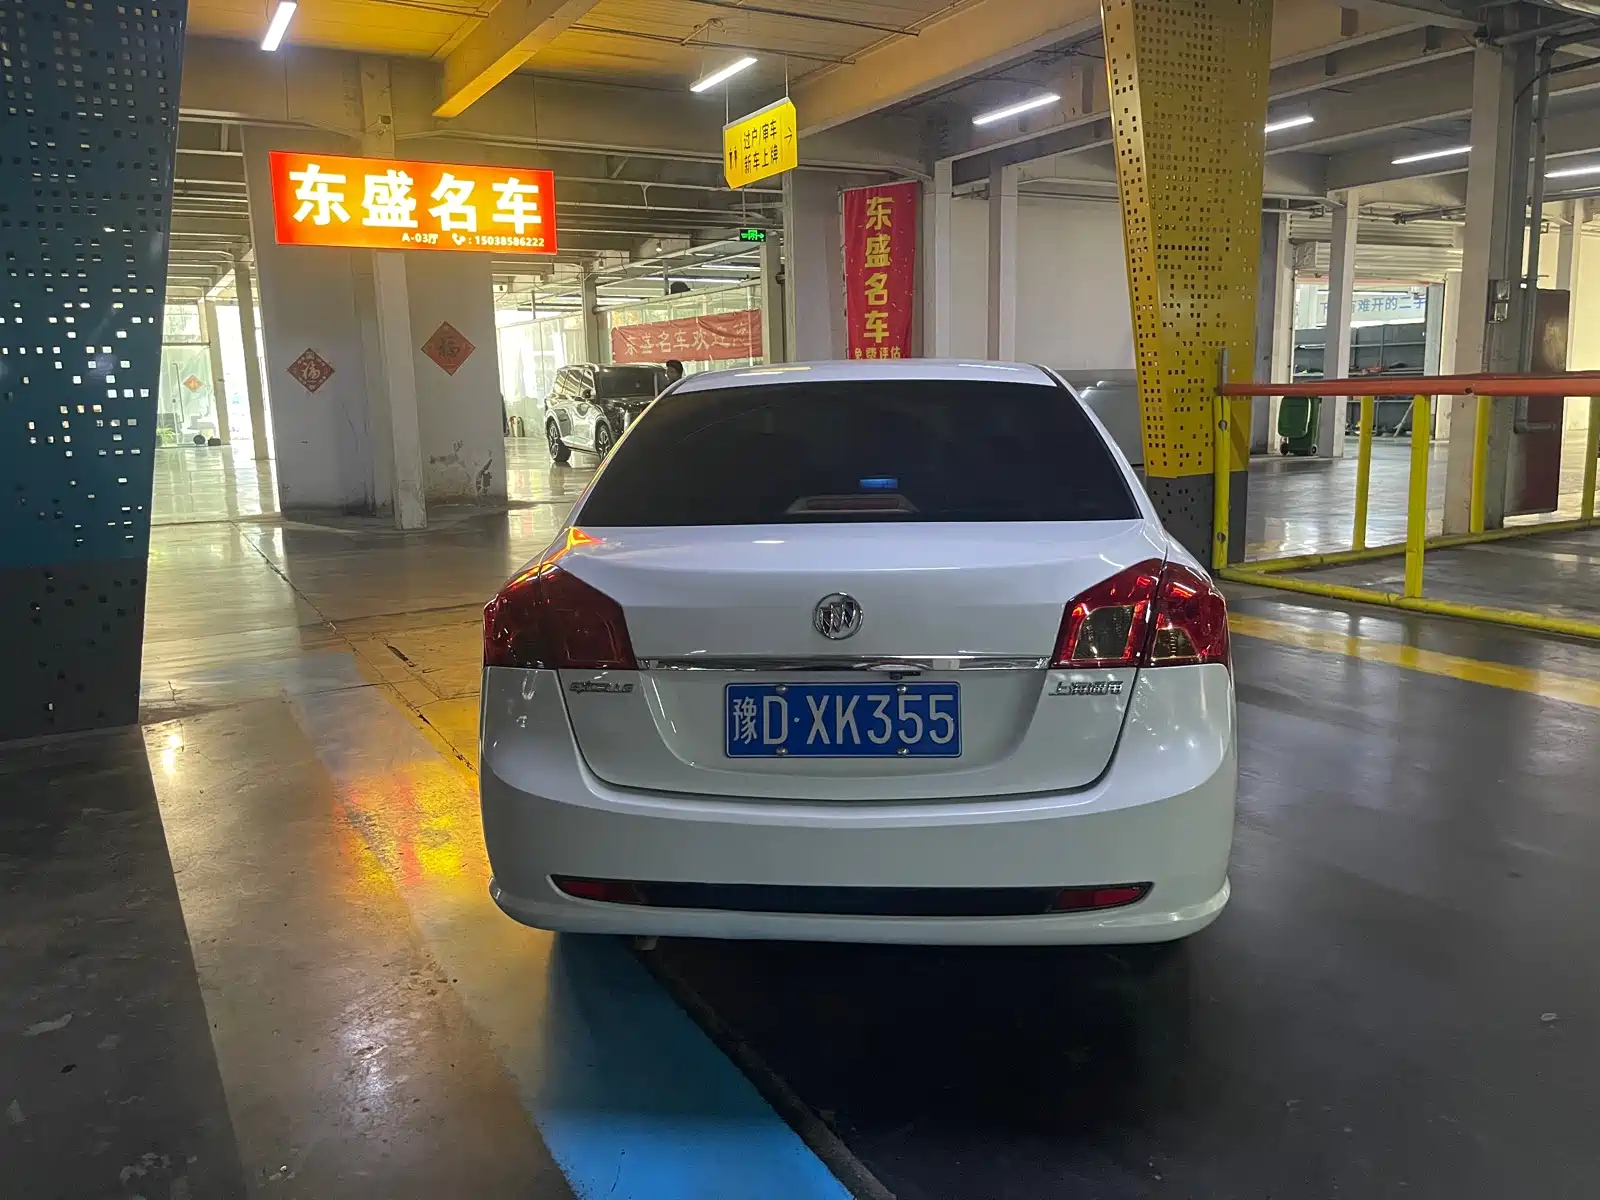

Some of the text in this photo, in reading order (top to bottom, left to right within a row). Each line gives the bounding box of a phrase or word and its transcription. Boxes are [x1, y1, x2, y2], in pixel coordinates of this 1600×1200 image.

[744, 144, 778, 174] 新车上牌
[289, 163, 542, 234] 东盛名车
[863, 196, 895, 343] 东盛名车
[732, 694, 955, 745] 豫D·XK355
